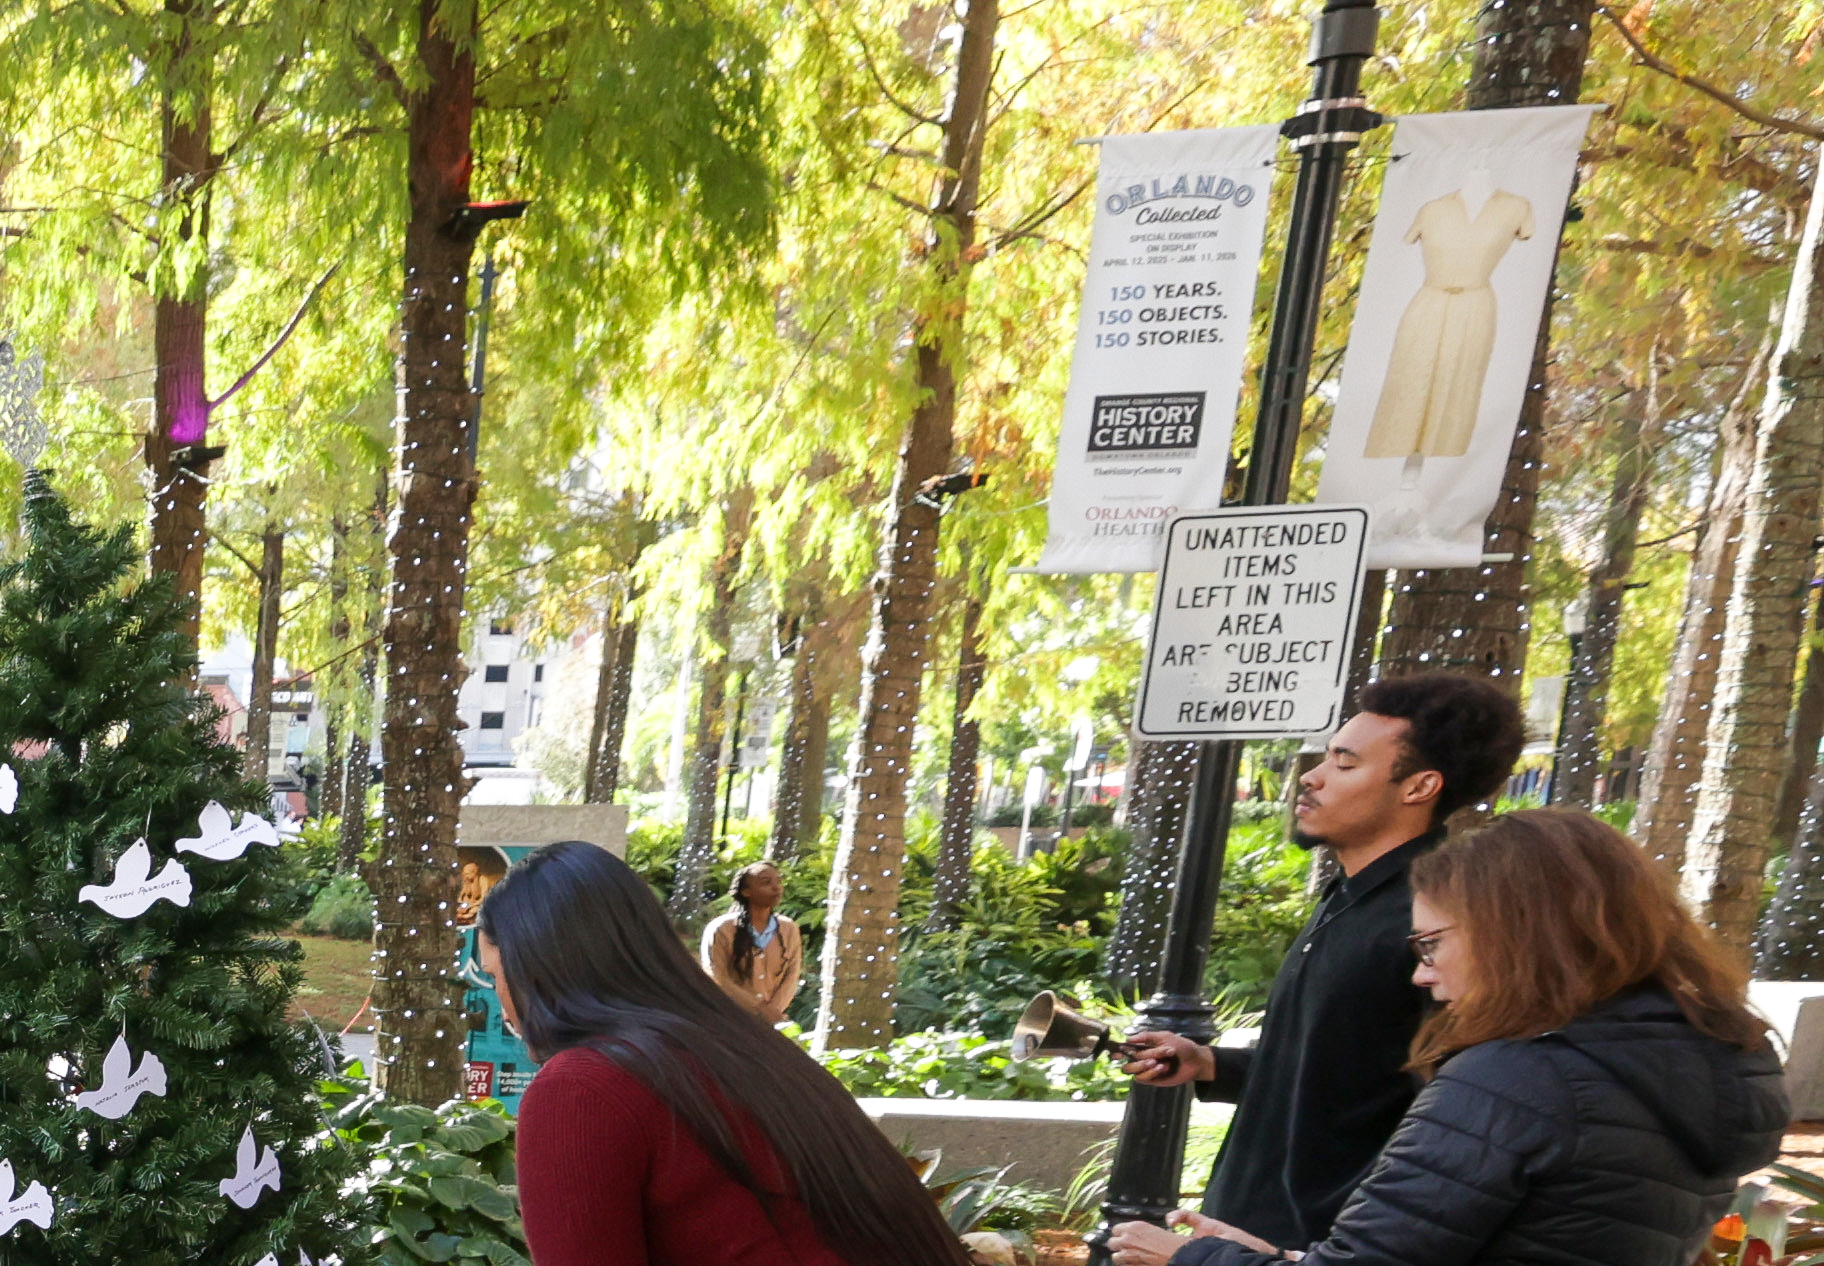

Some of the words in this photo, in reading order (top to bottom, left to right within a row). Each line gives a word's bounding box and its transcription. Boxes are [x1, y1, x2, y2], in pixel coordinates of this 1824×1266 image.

[1106, 174, 1255, 215] ORLANDO
[1136, 205, 1222, 225] Collected
[1129, 233, 1166, 243] SPECIAL
[1168, 230, 1219, 241] EXHIBITION
[1162, 243, 1199, 251] DISPLAY
[1103, 258, 1129, 267] APRIL
[1110, 285, 1146, 301] 150
[1152, 281, 1223, 299] YEARS.
[1098, 309, 1133, 325] 150
[1139, 304, 1229, 323] OBJECTS.
[1095, 332, 1130, 348] 150
[1136, 328, 1225, 346] STORIES.
[1097, 404, 1199, 427] HISTORY
[1094, 425, 1195, 447] CENTER
[1094, 520, 1166, 537] HEALTH
[1185, 522, 1347, 551] UNATTENDED
[1223, 553, 1298, 578] ITEMS
[1175, 585, 1236, 609] LEFT
[1246, 584, 1271, 606] IN
[1283, 581, 1337, 605] THIS
[1217, 612, 1284, 636] AREA
[1226, 670, 1299, 693] BEING
[1177, 700, 1295, 724] REMOVED
